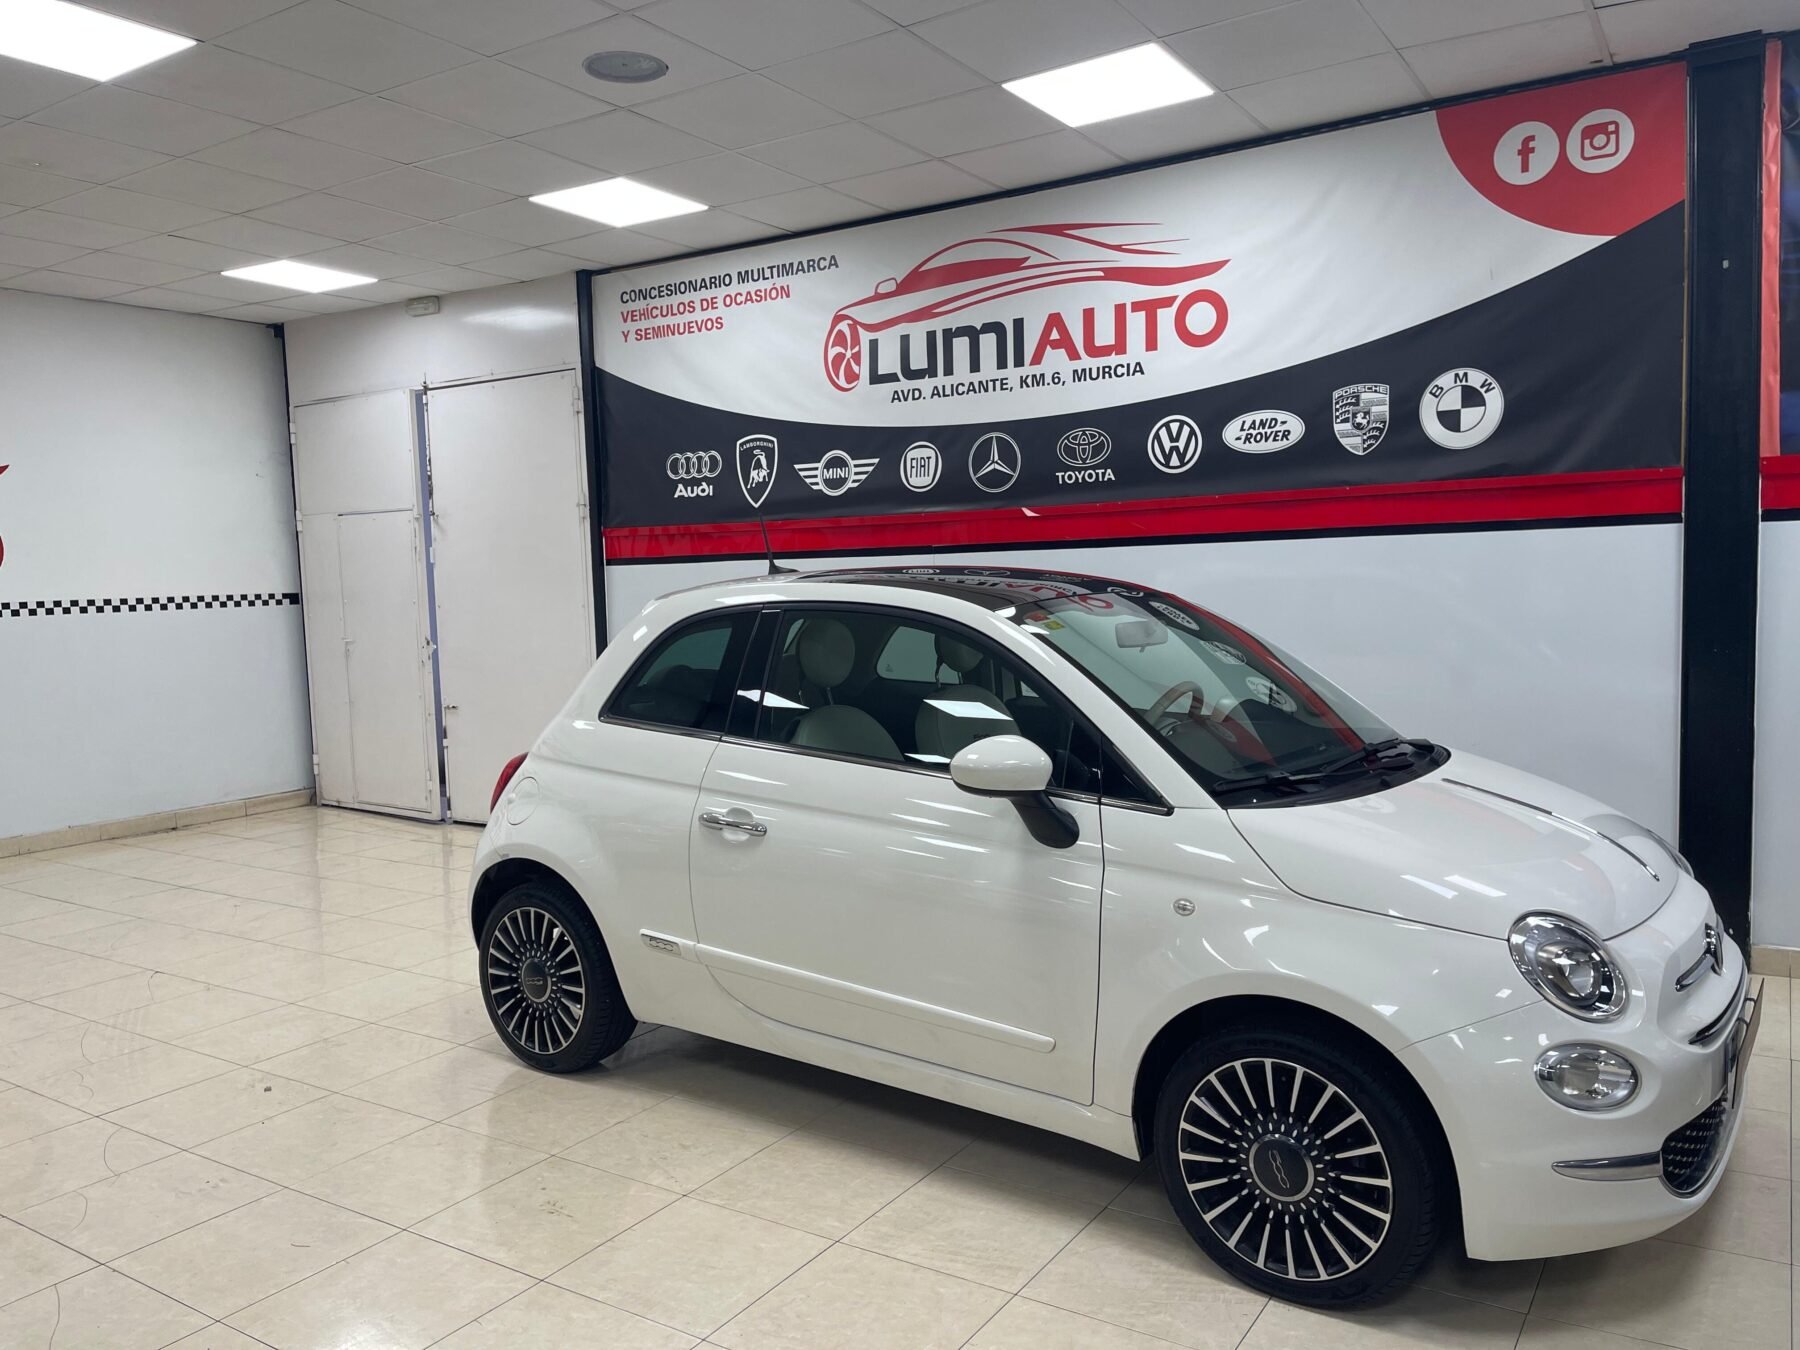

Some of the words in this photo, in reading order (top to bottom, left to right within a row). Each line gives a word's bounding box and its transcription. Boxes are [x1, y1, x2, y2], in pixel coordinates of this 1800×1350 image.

[620, 273, 733, 304] CONCESIONARIO
[737, 255, 839, 285] MULTIMARCA
[621, 300, 696, 324] VEHÍCULOS
[700, 296, 718, 312] DE
[723, 283, 791, 307] OCASIÓN
[621, 330, 630, 343] Y
[634, 316, 724, 342] SEMINUEVOS
[890, 387, 926, 404] AVD.
[930, 377, 1014, 400] ALICANTE,
[1019, 370, 1067, 391] KM.6,
[1072, 361, 1145, 383] MURCIA
[1335, 384, 1388, 399] PORSCHE
[740, 441, 774, 451] LAMBORGHINI
[823, 467, 849, 480] MINI
[910, 456, 932, 479] FIAT
[1056, 468, 1115, 484] TOYOTA
[674, 482, 713, 498] Audi
